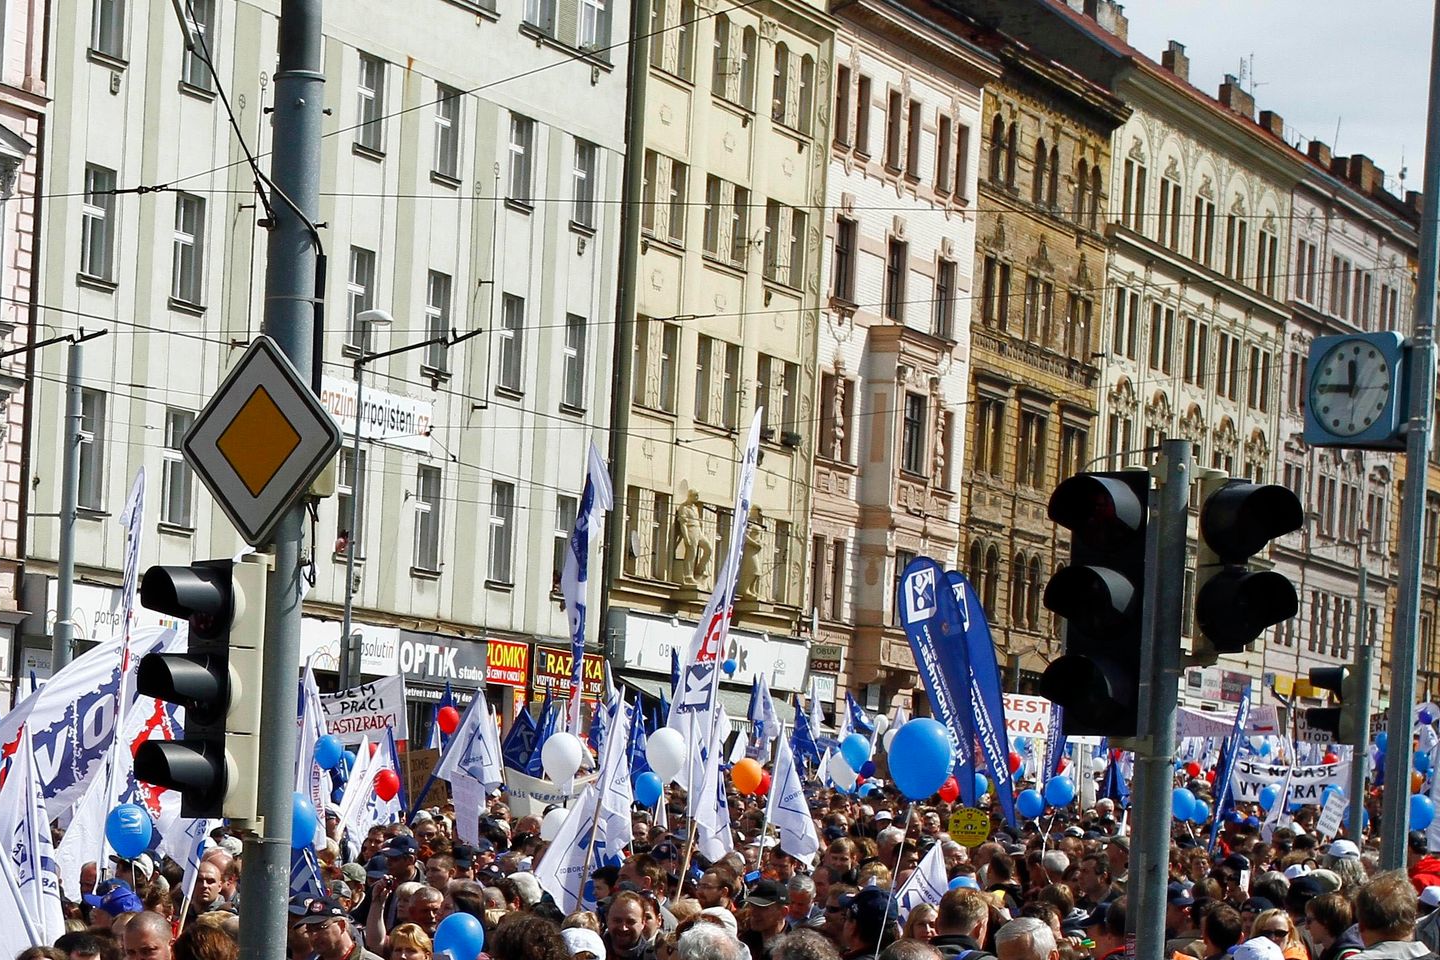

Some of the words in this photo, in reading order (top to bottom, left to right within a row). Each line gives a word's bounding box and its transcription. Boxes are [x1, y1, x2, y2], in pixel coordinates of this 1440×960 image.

[458, 666, 484, 681] studio
[546, 653, 603, 680] RAZTKA
[325, 712, 397, 735] LASTIZRÁDCI
